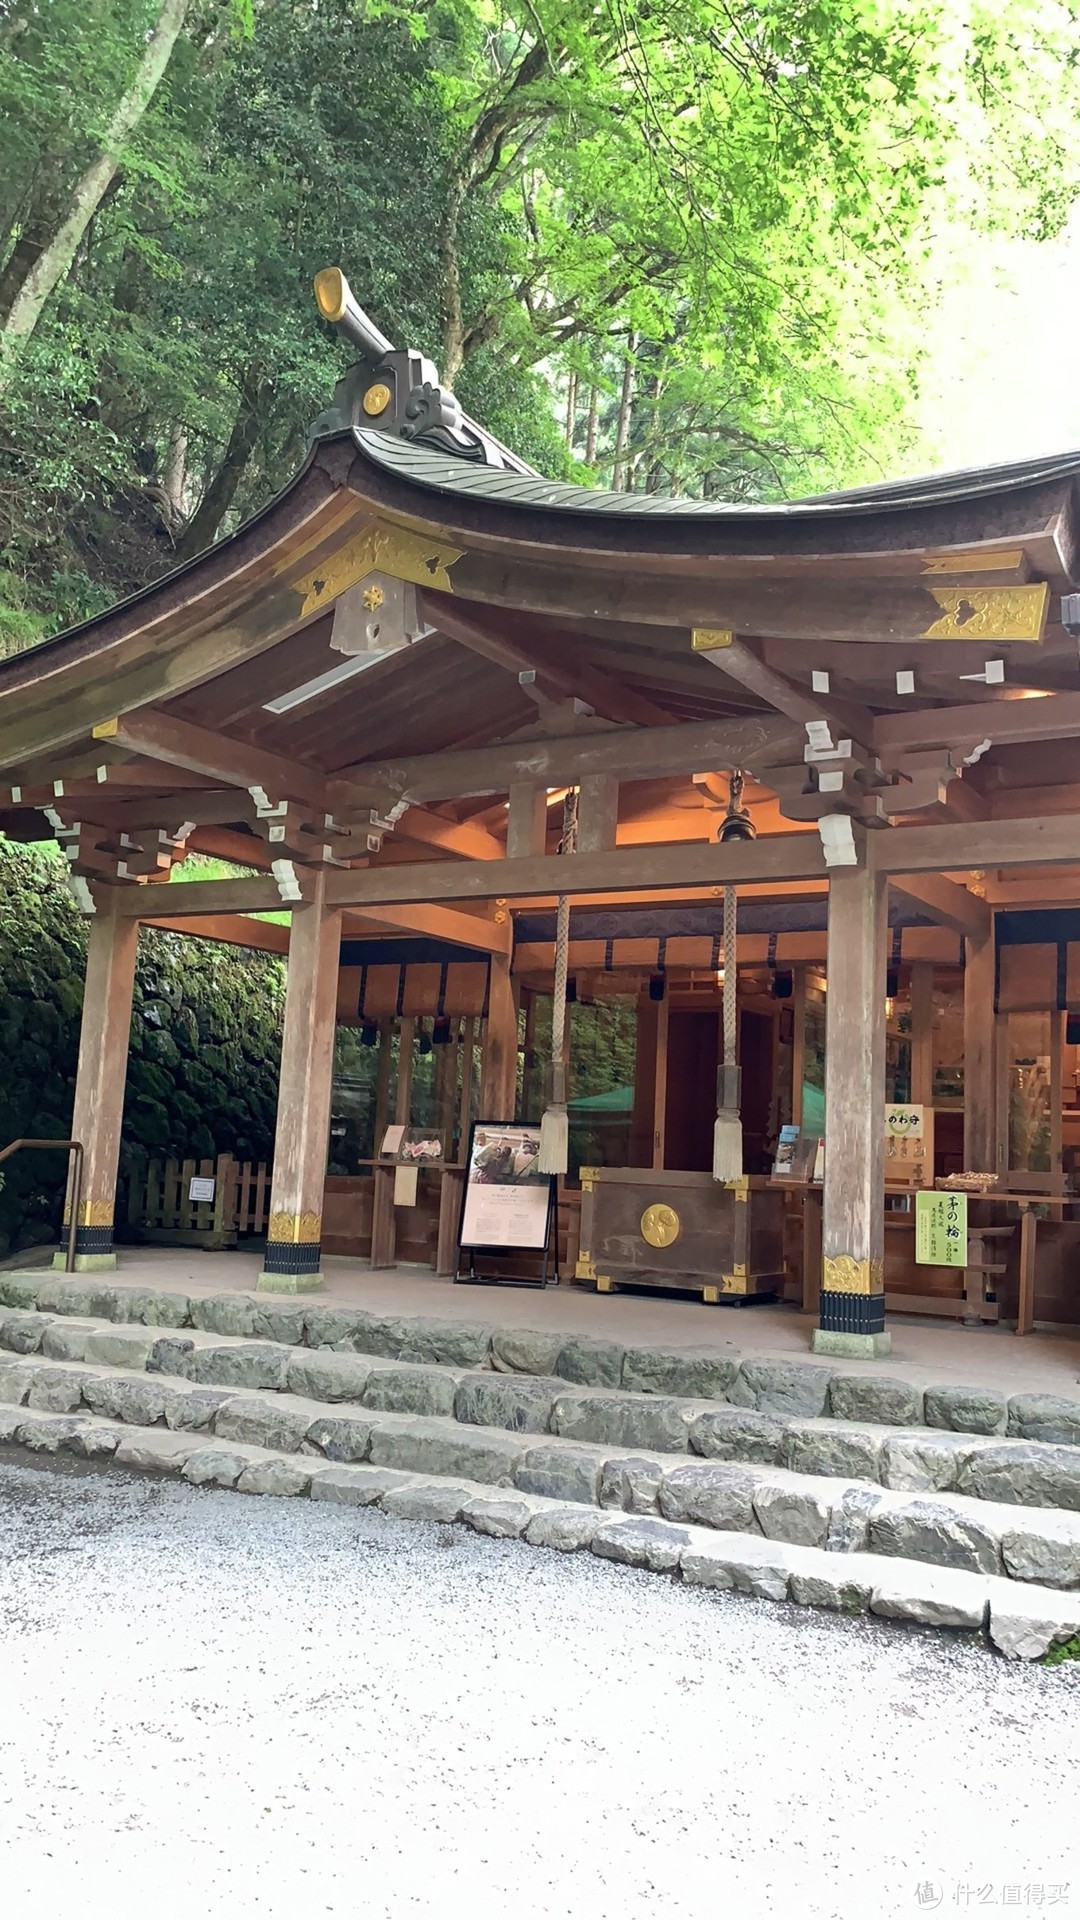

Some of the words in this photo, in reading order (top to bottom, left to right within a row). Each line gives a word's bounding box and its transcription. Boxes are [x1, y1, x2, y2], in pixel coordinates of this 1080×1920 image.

[884, 1114, 920, 1127] のわ守
[946, 1196, 960, 1238] 茅の輪
